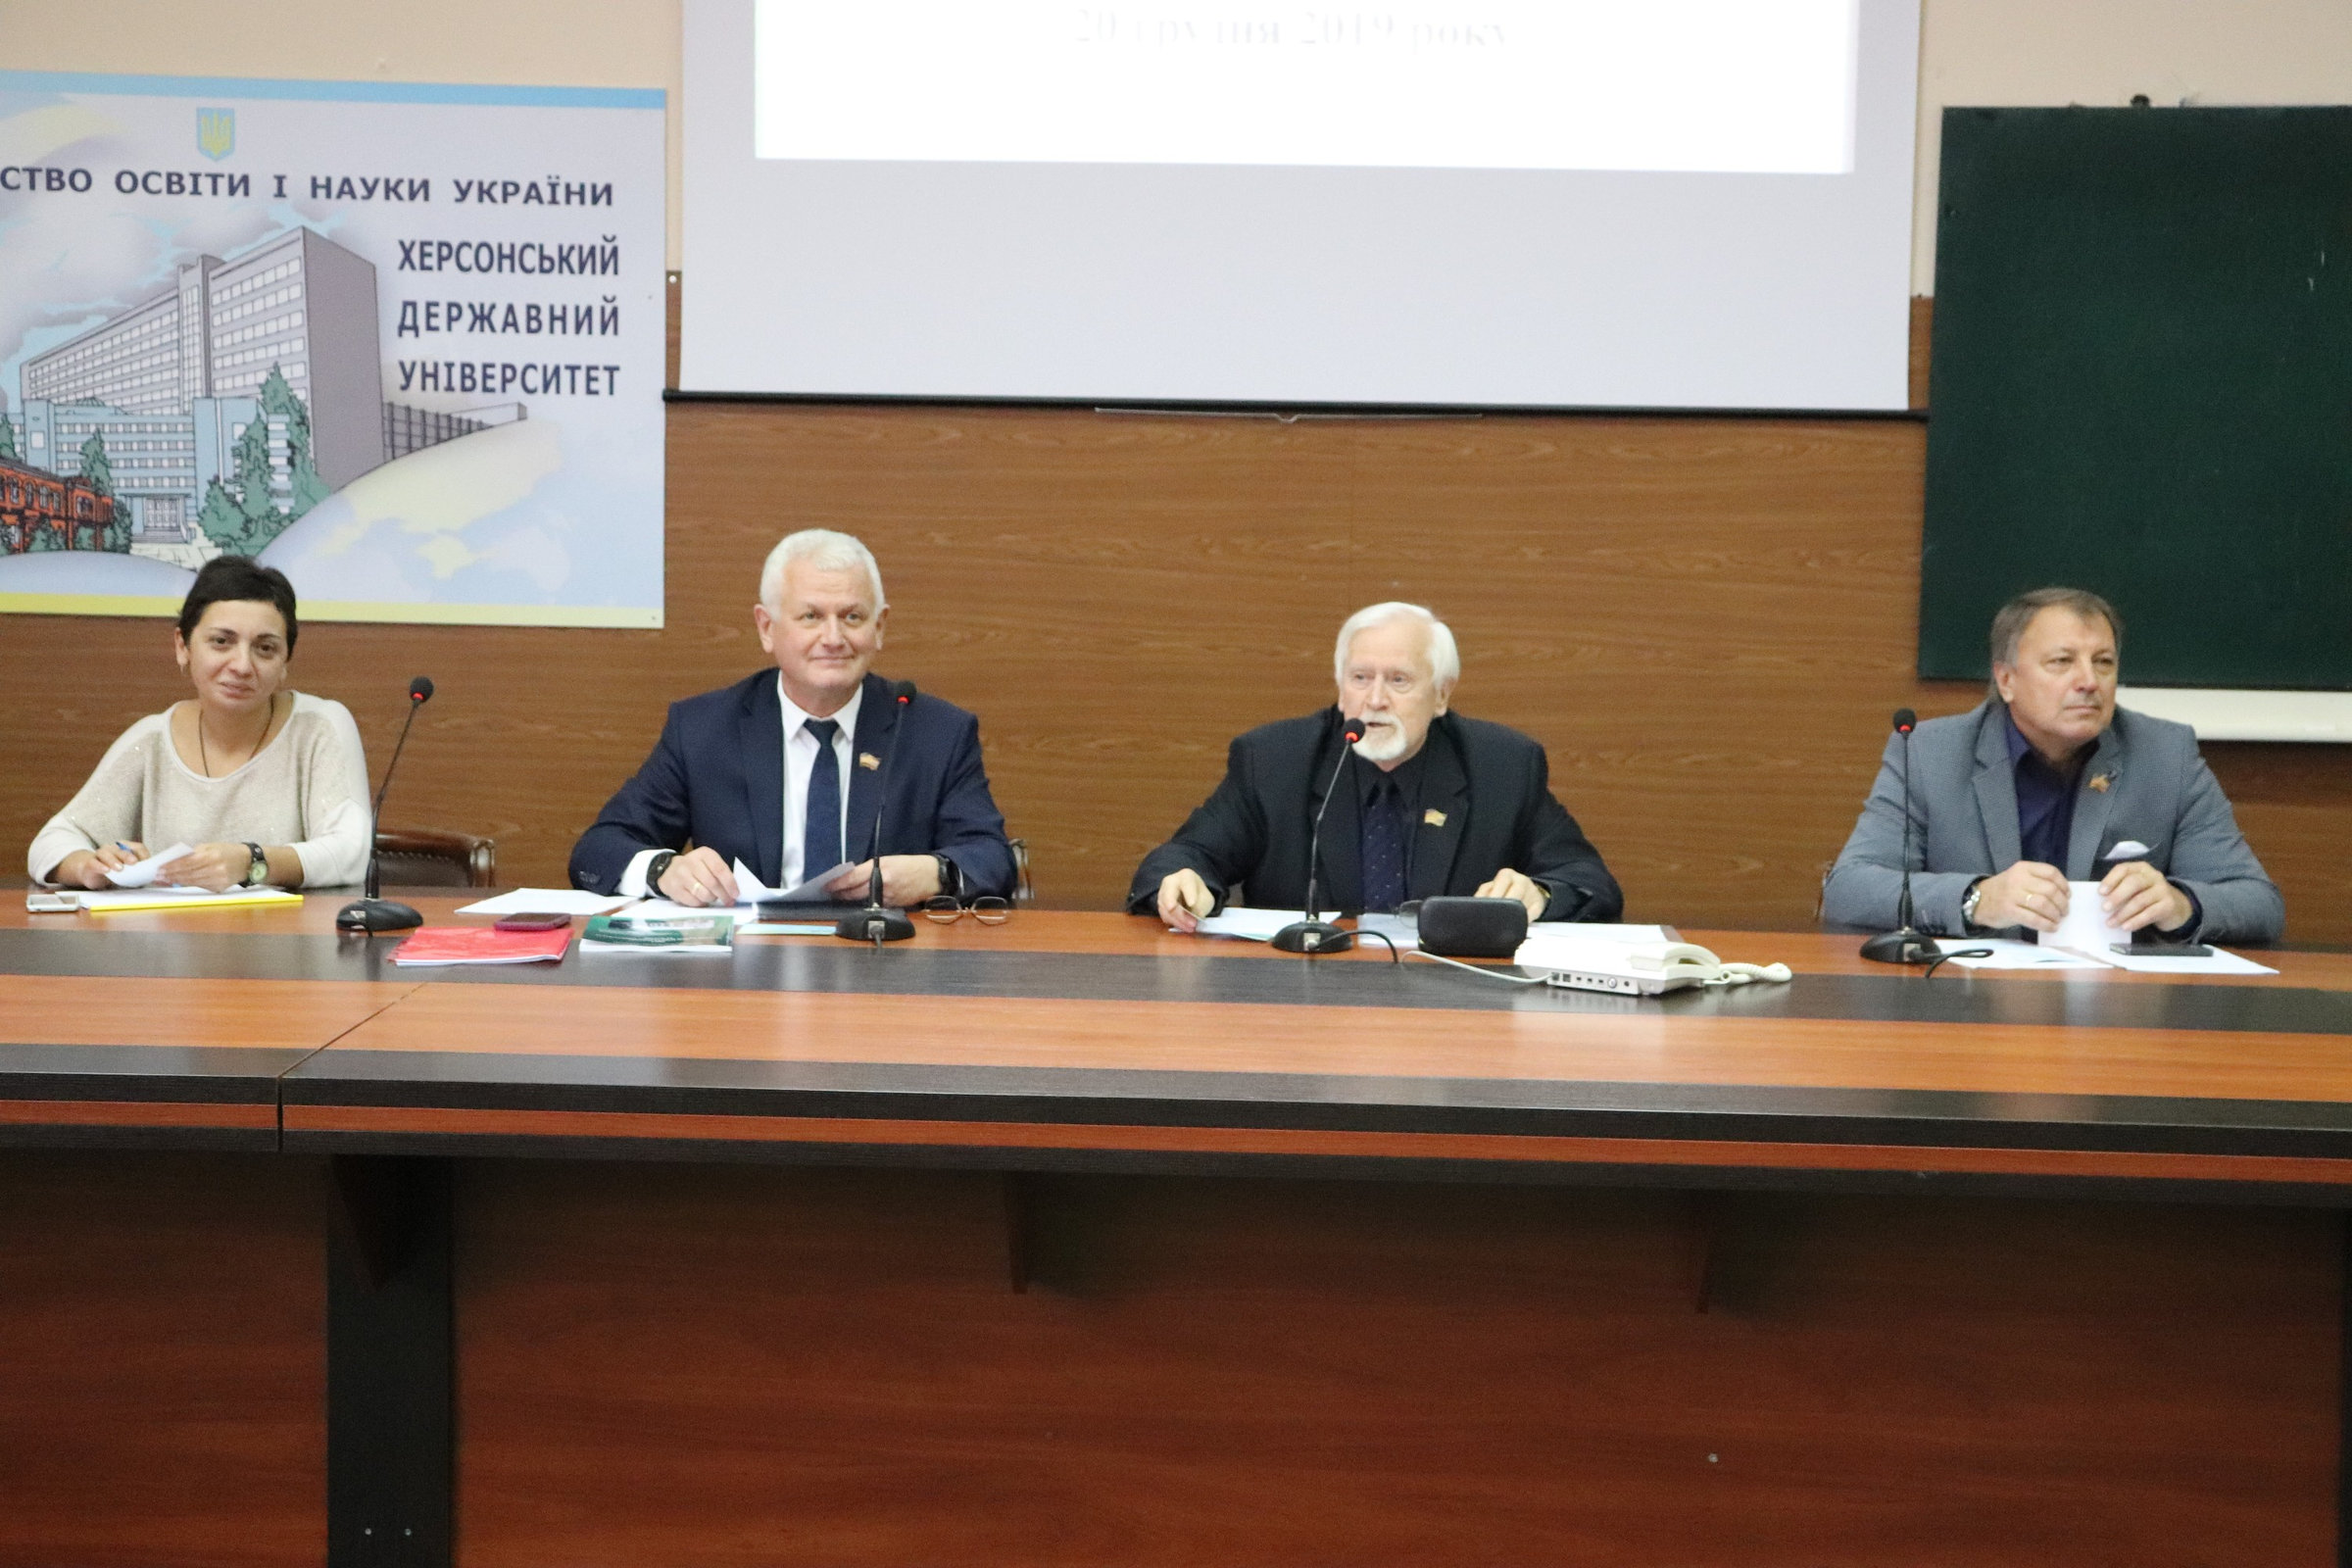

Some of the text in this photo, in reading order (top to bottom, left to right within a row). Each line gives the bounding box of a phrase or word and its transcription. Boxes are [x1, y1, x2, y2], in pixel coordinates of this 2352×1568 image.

[1074, 9, 1118, 42] 20
[1298, 11, 1395, 46] 2019
[0, 166, 613, 207] СТВО ОСВІТИ І НАУКИ УКРАЇНИ
[398, 233, 619, 276] ХЕРСОНСЬКИЙ
[397, 294, 619, 338] ДЕРЖАВНИЙ
[398, 360, 620, 396] УНІВЕРСИТЕТ
